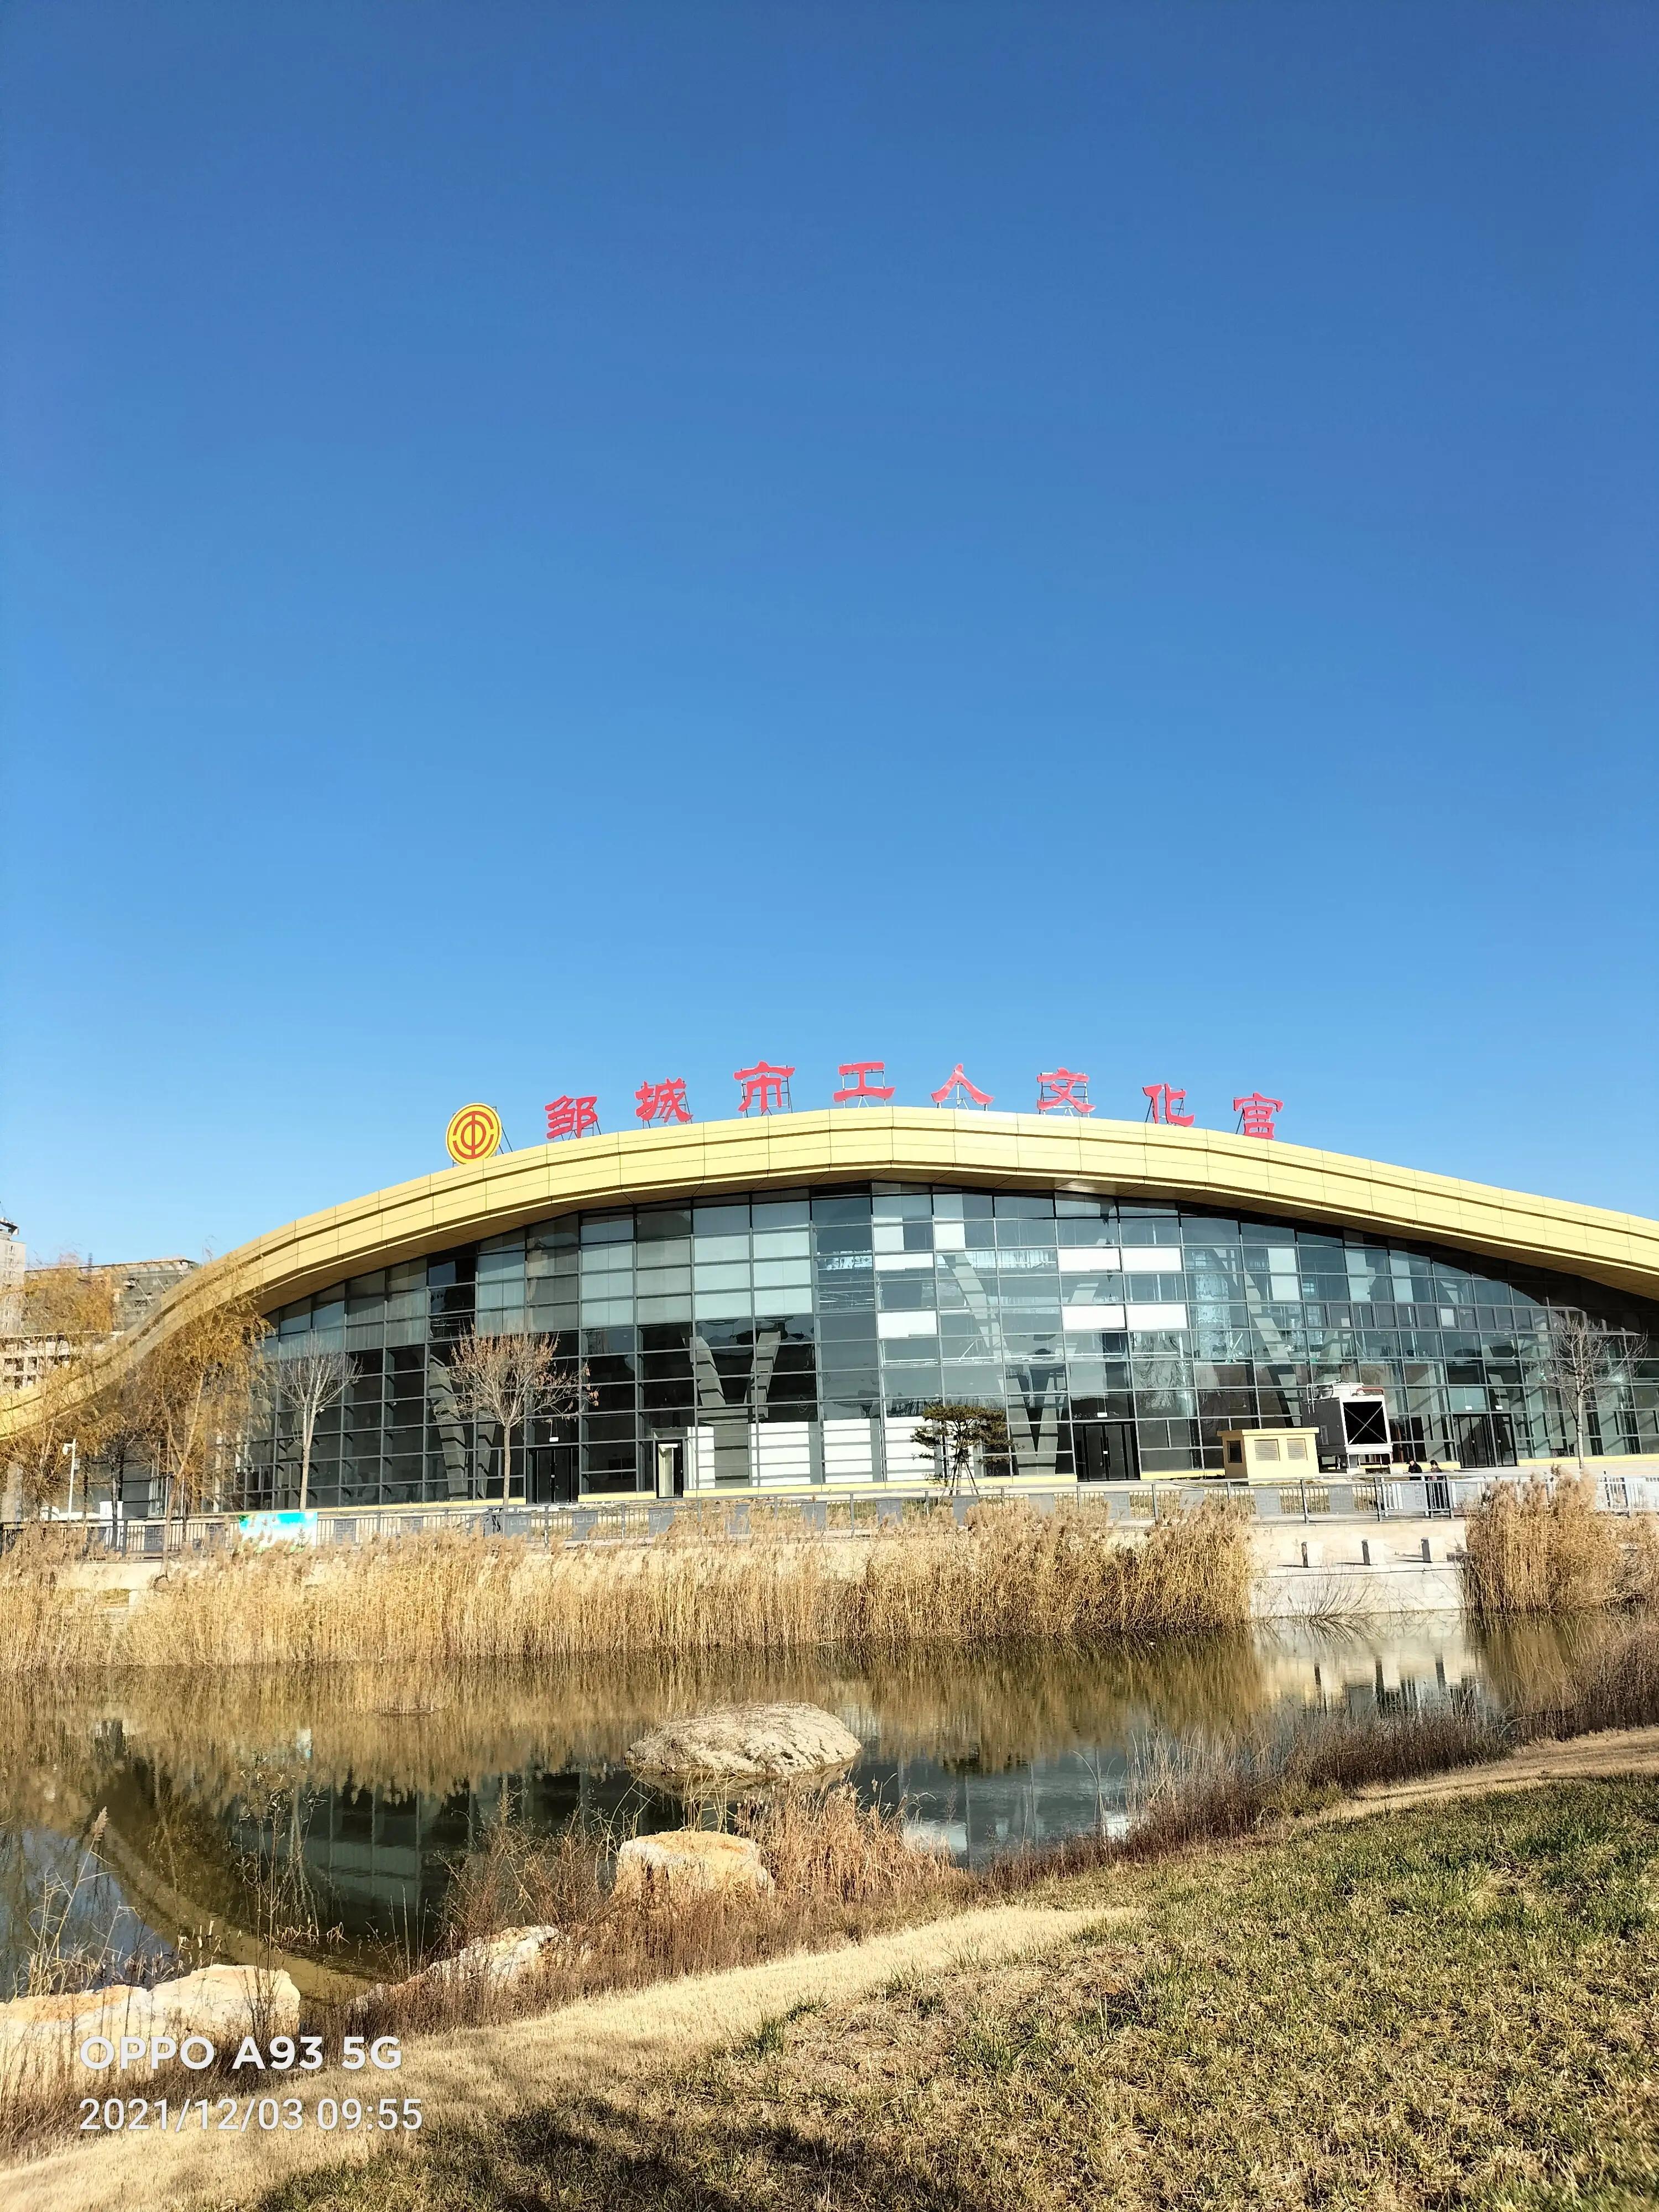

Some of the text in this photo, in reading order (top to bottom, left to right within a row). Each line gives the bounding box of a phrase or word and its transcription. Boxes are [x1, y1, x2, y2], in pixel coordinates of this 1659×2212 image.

[545, 1061, 1284, 1140] 邹城市工人文化宫
